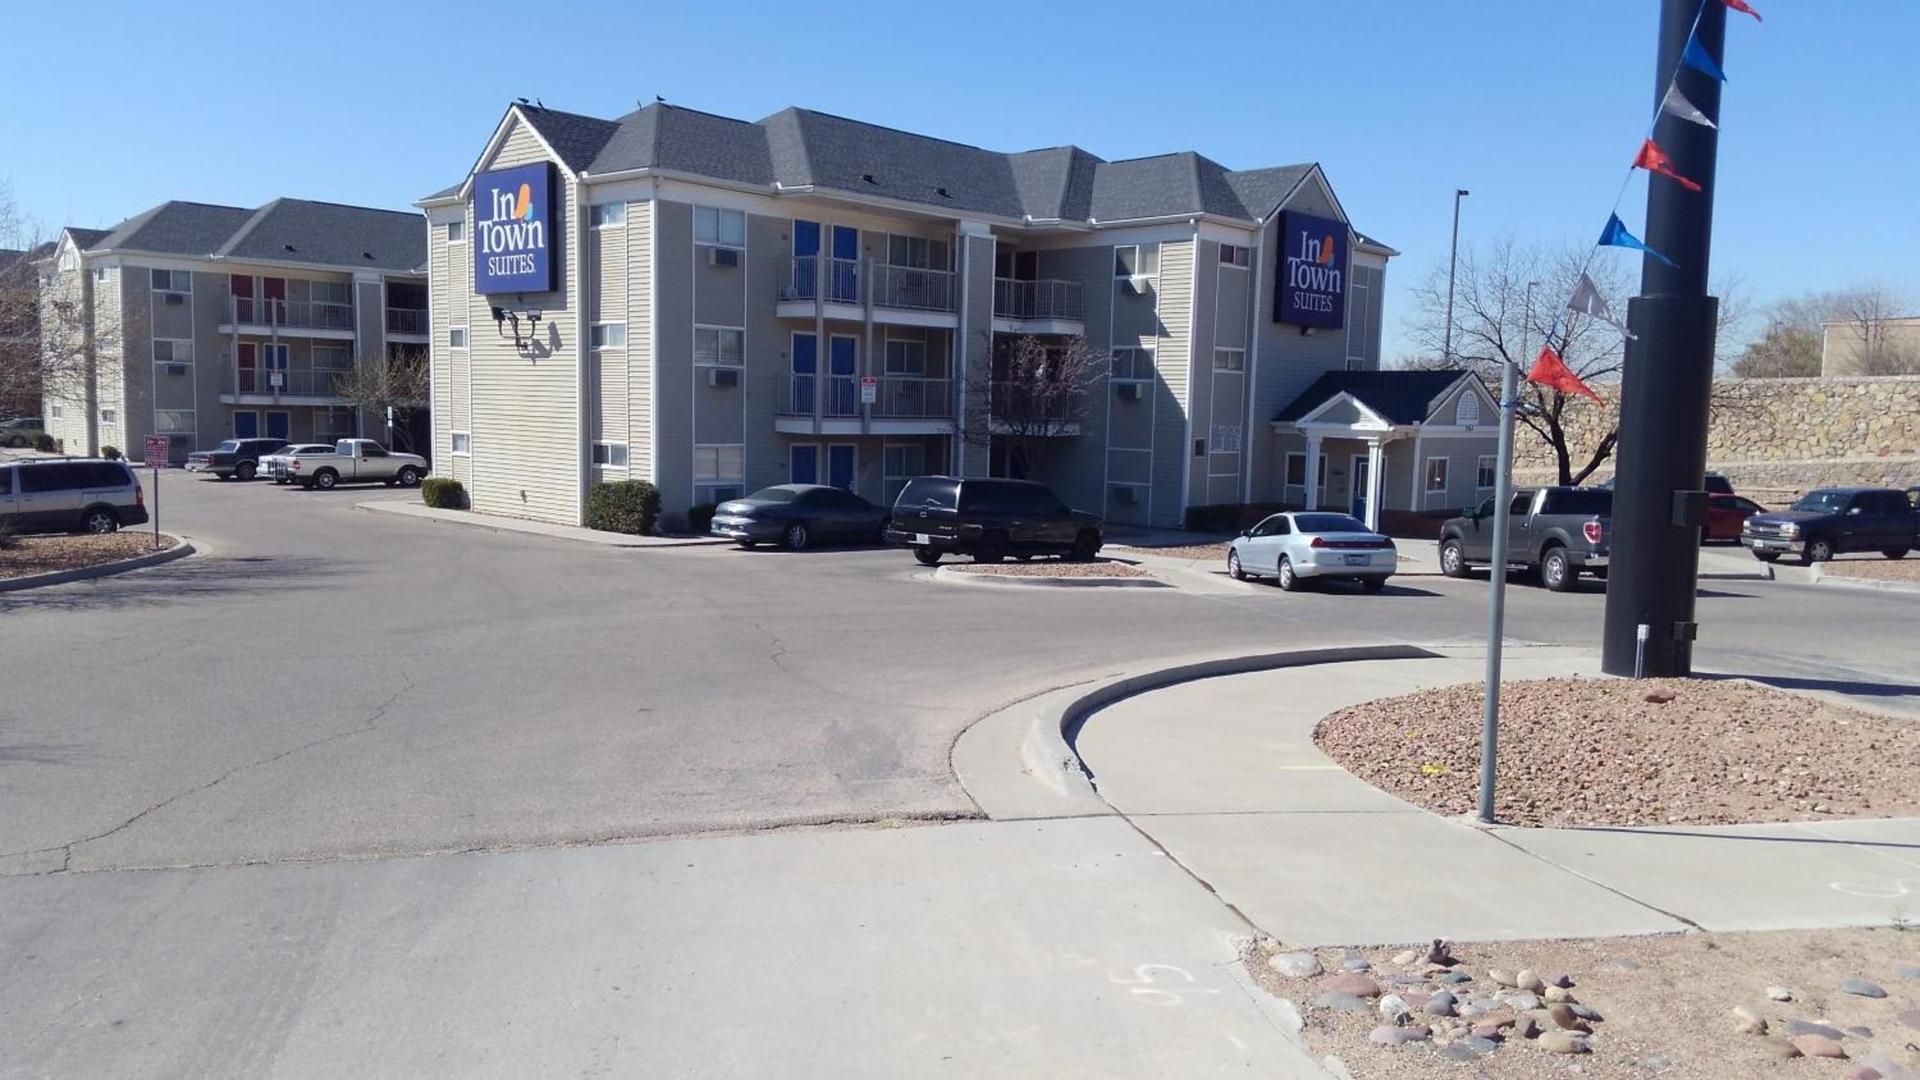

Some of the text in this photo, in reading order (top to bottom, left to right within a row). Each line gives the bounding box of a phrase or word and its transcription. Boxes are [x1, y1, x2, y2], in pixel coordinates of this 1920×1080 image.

[491, 188, 516, 221] In
[478, 219, 545, 254] Town
[1301, 231, 1321, 262] In
[488, 253, 534, 276] SUITES
[1287, 256, 1342, 293] Town
[1293, 291, 1334, 312] SUITES
